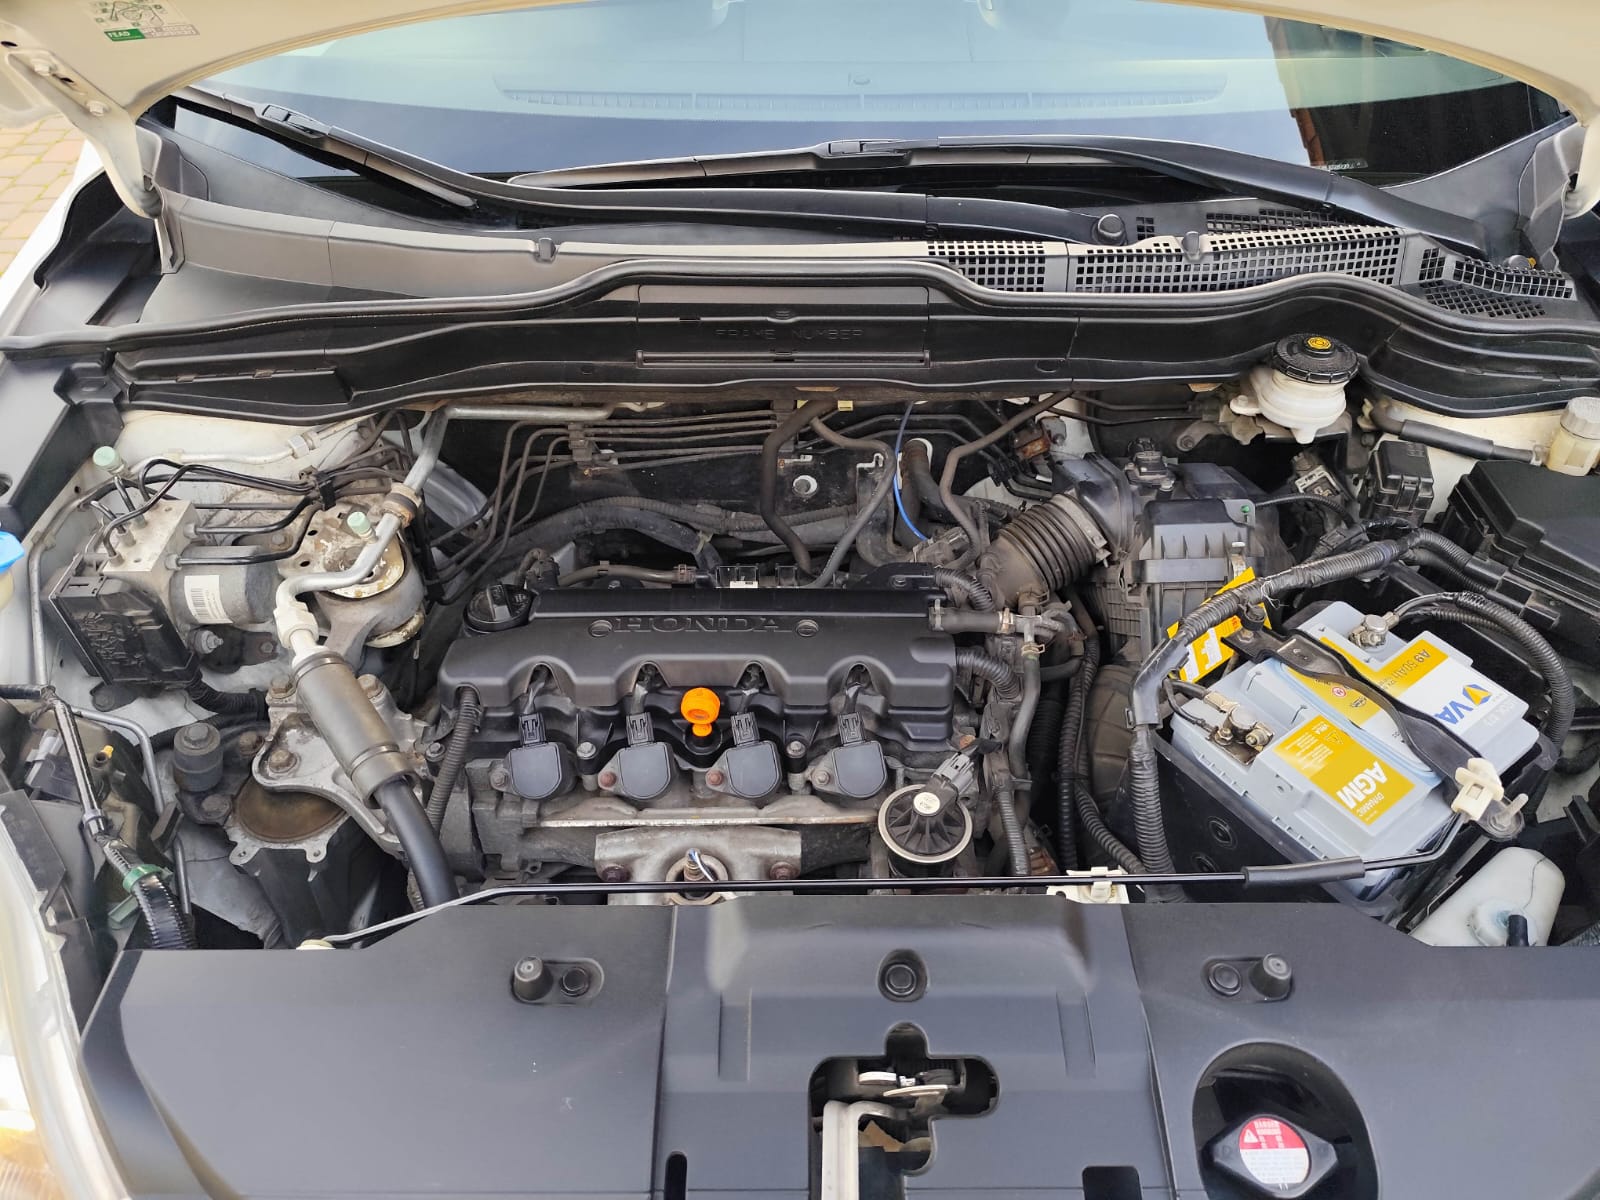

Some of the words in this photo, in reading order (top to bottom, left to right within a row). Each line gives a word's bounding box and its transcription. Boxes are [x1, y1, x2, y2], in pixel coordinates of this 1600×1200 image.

[715, 328, 777, 340] FRAME
[792, 328, 864, 340] NUMBER
[613, 617, 793, 633] HONDA
[1335, 760, 1388, 810] AGM
